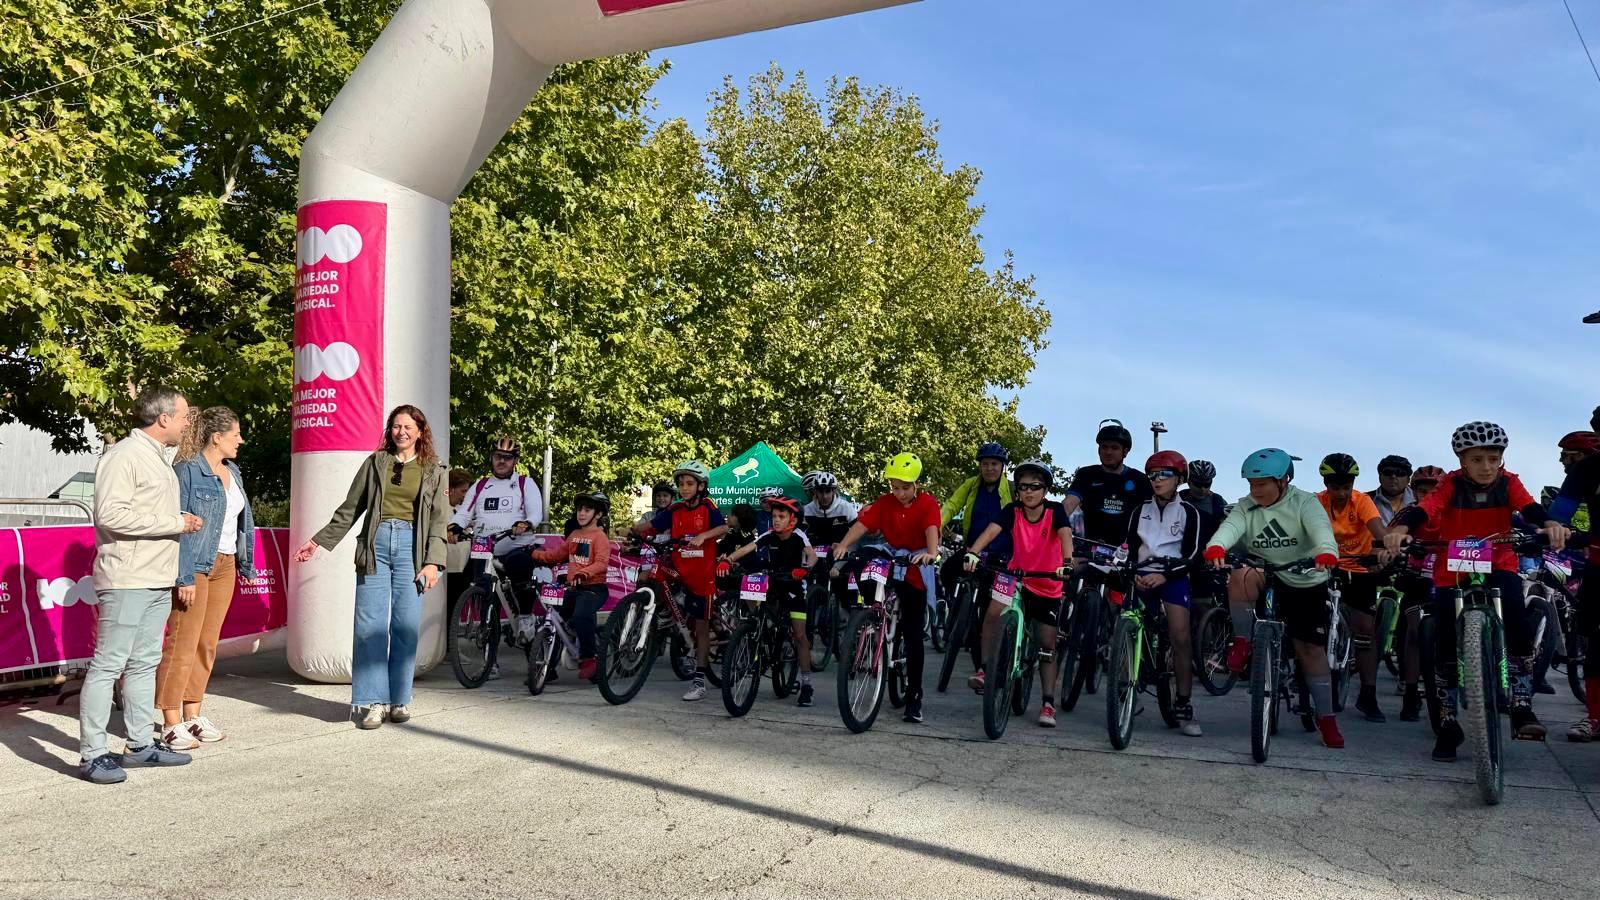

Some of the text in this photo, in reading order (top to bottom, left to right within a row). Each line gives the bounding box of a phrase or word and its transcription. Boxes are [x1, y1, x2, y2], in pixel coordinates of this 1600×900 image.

[303, 270, 339, 283] MEJOR
[296, 284, 339, 300] VARIEDAD
[295, 298, 336, 313] MUSICAL.
[300, 388, 337, 401] MEJOR
[294, 402, 337, 416] VARIEDAD
[293, 416, 334, 429] MUSICAL.
[726, 485, 762, 496] Municip
[735, 497, 747, 505] de
[1252, 537, 1298, 548] adidas
[1458, 549, 1481, 559] 416
[238, 577, 276, 586] VAEDAD
[240, 586, 277, 595] MUSICAL.
[747, 583, 761, 592] 130
[995, 583, 1008, 594] 483
